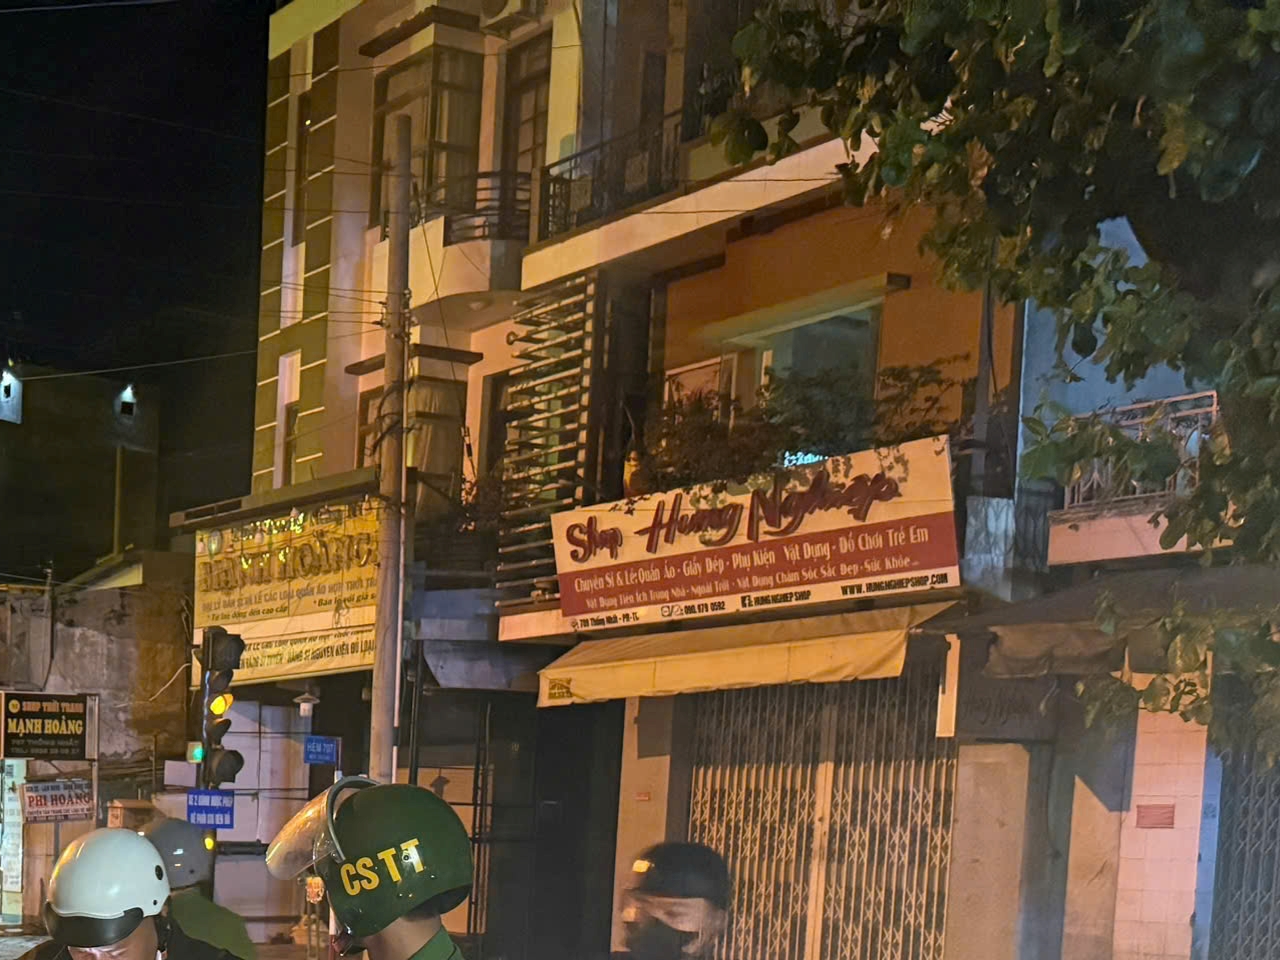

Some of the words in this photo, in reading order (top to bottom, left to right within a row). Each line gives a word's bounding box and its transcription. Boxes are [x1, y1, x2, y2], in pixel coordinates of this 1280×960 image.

[803, 541, 831, 562] Dụng
[909, 525, 929, 543] Em
[7, 717, 42, 737] MẠNH
[44, 714, 84, 735] HOÀNG
[27, 794, 48, 808] PHI
[340, 837, 425, 897] CSTT
